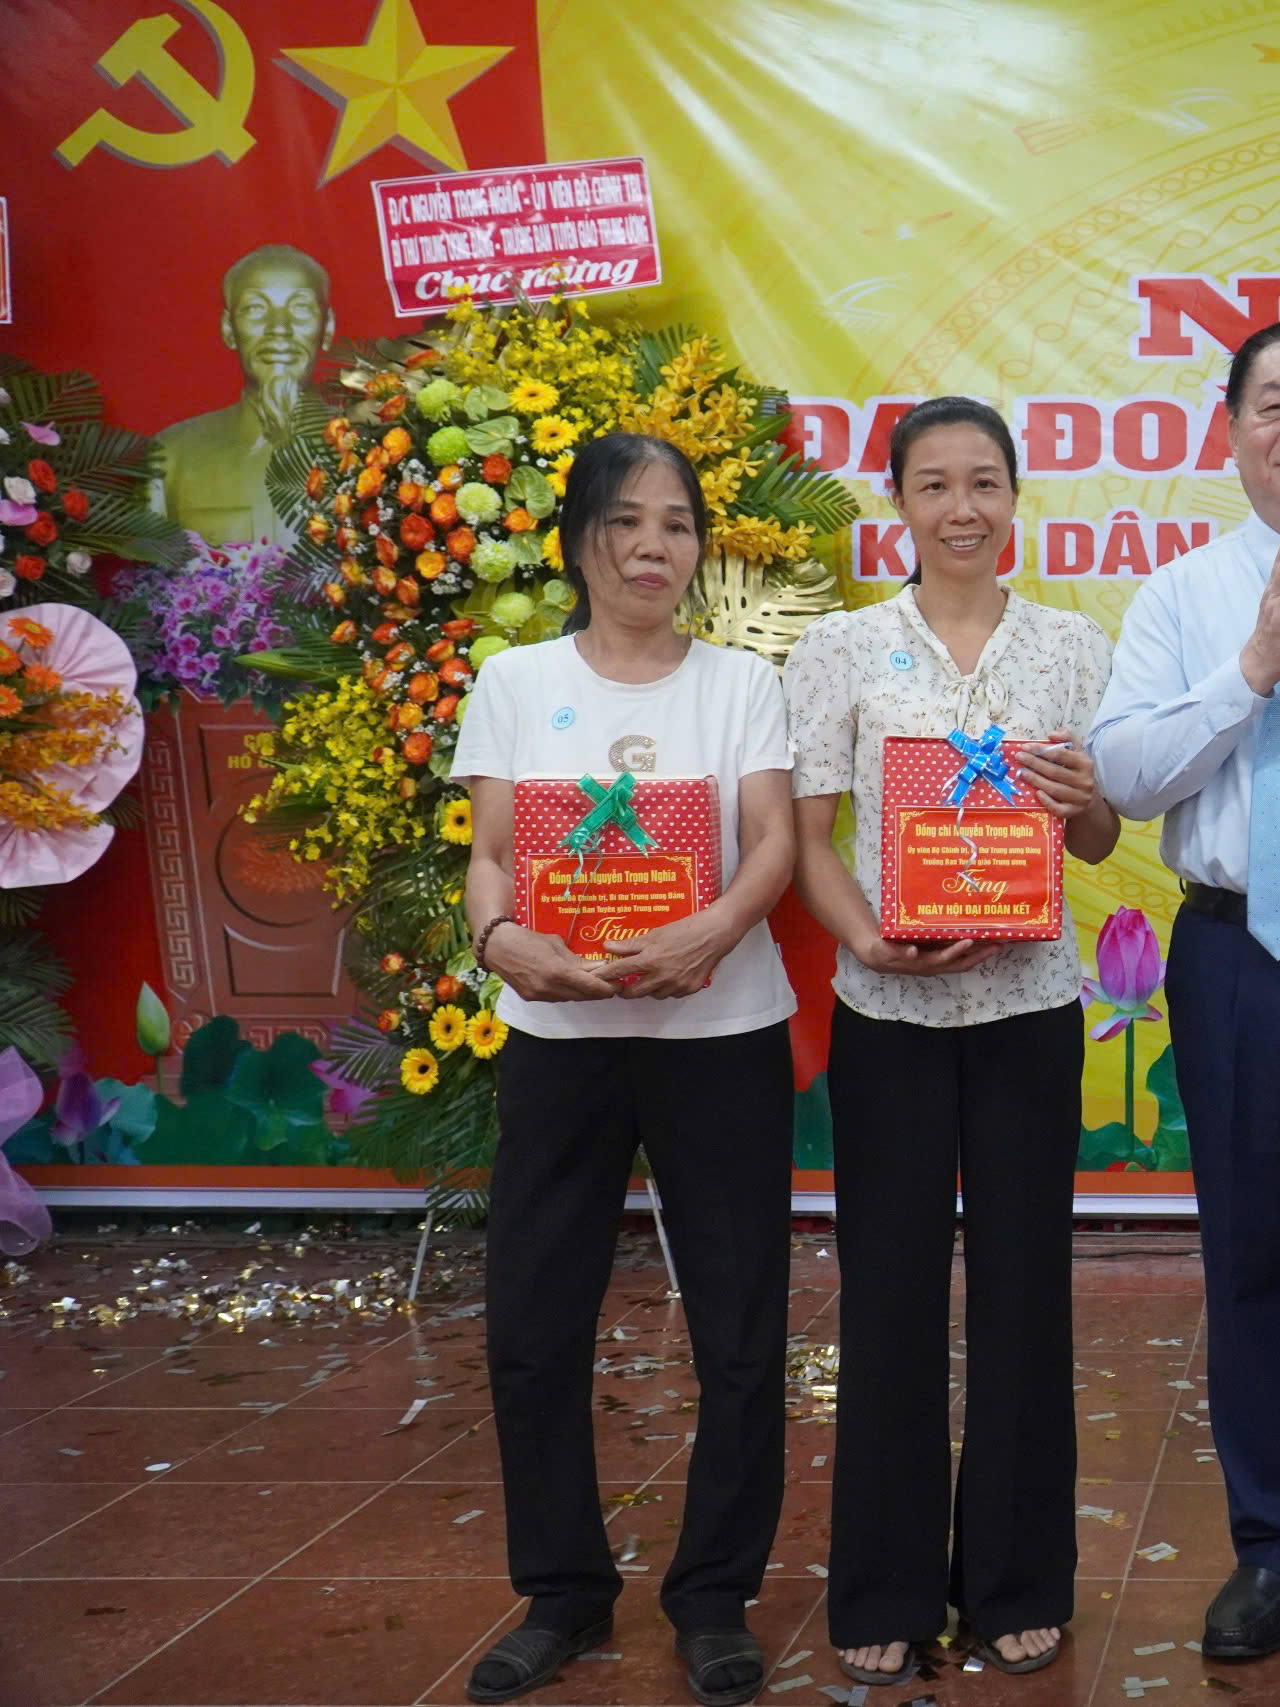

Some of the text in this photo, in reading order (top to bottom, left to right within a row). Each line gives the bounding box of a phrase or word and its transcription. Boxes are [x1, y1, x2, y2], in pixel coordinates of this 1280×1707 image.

[415, 263, 512, 299] Chúc
[778, 403, 916, 488] ĐẠ
[1047, 510, 1210, 575] DÂN
[608, 735, 656, 772] G
[918, 901, 1030, 916] NGÀY HỘI ĐẠI ĐOÀN KẾT
